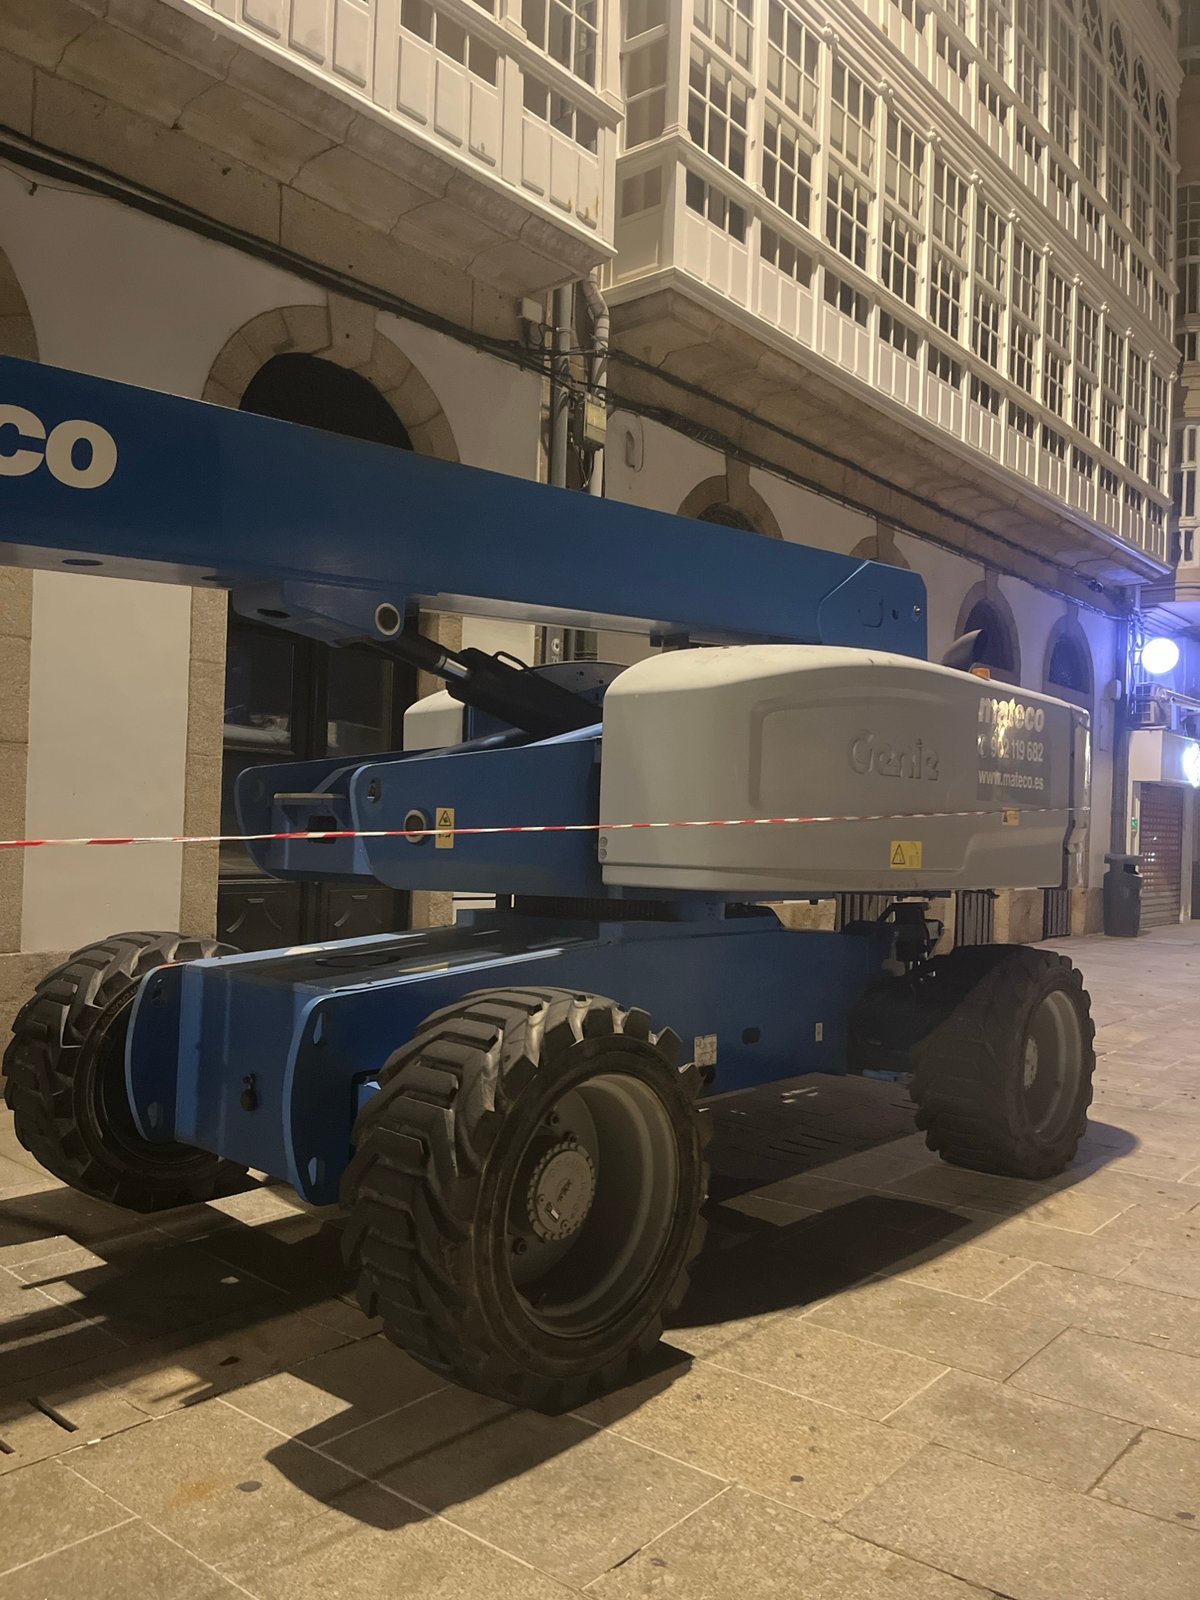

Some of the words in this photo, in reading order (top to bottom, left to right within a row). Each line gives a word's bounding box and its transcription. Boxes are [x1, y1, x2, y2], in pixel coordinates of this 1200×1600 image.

[978, 697, 1045, 732] mateco
[849, 729, 940, 782] Genie
[990, 736, 1010, 759] 902
[1011, 739, 1026, 761] 119
[1026, 741, 1044, 762] 682
[978, 769, 1044, 790] www.mateco.es
